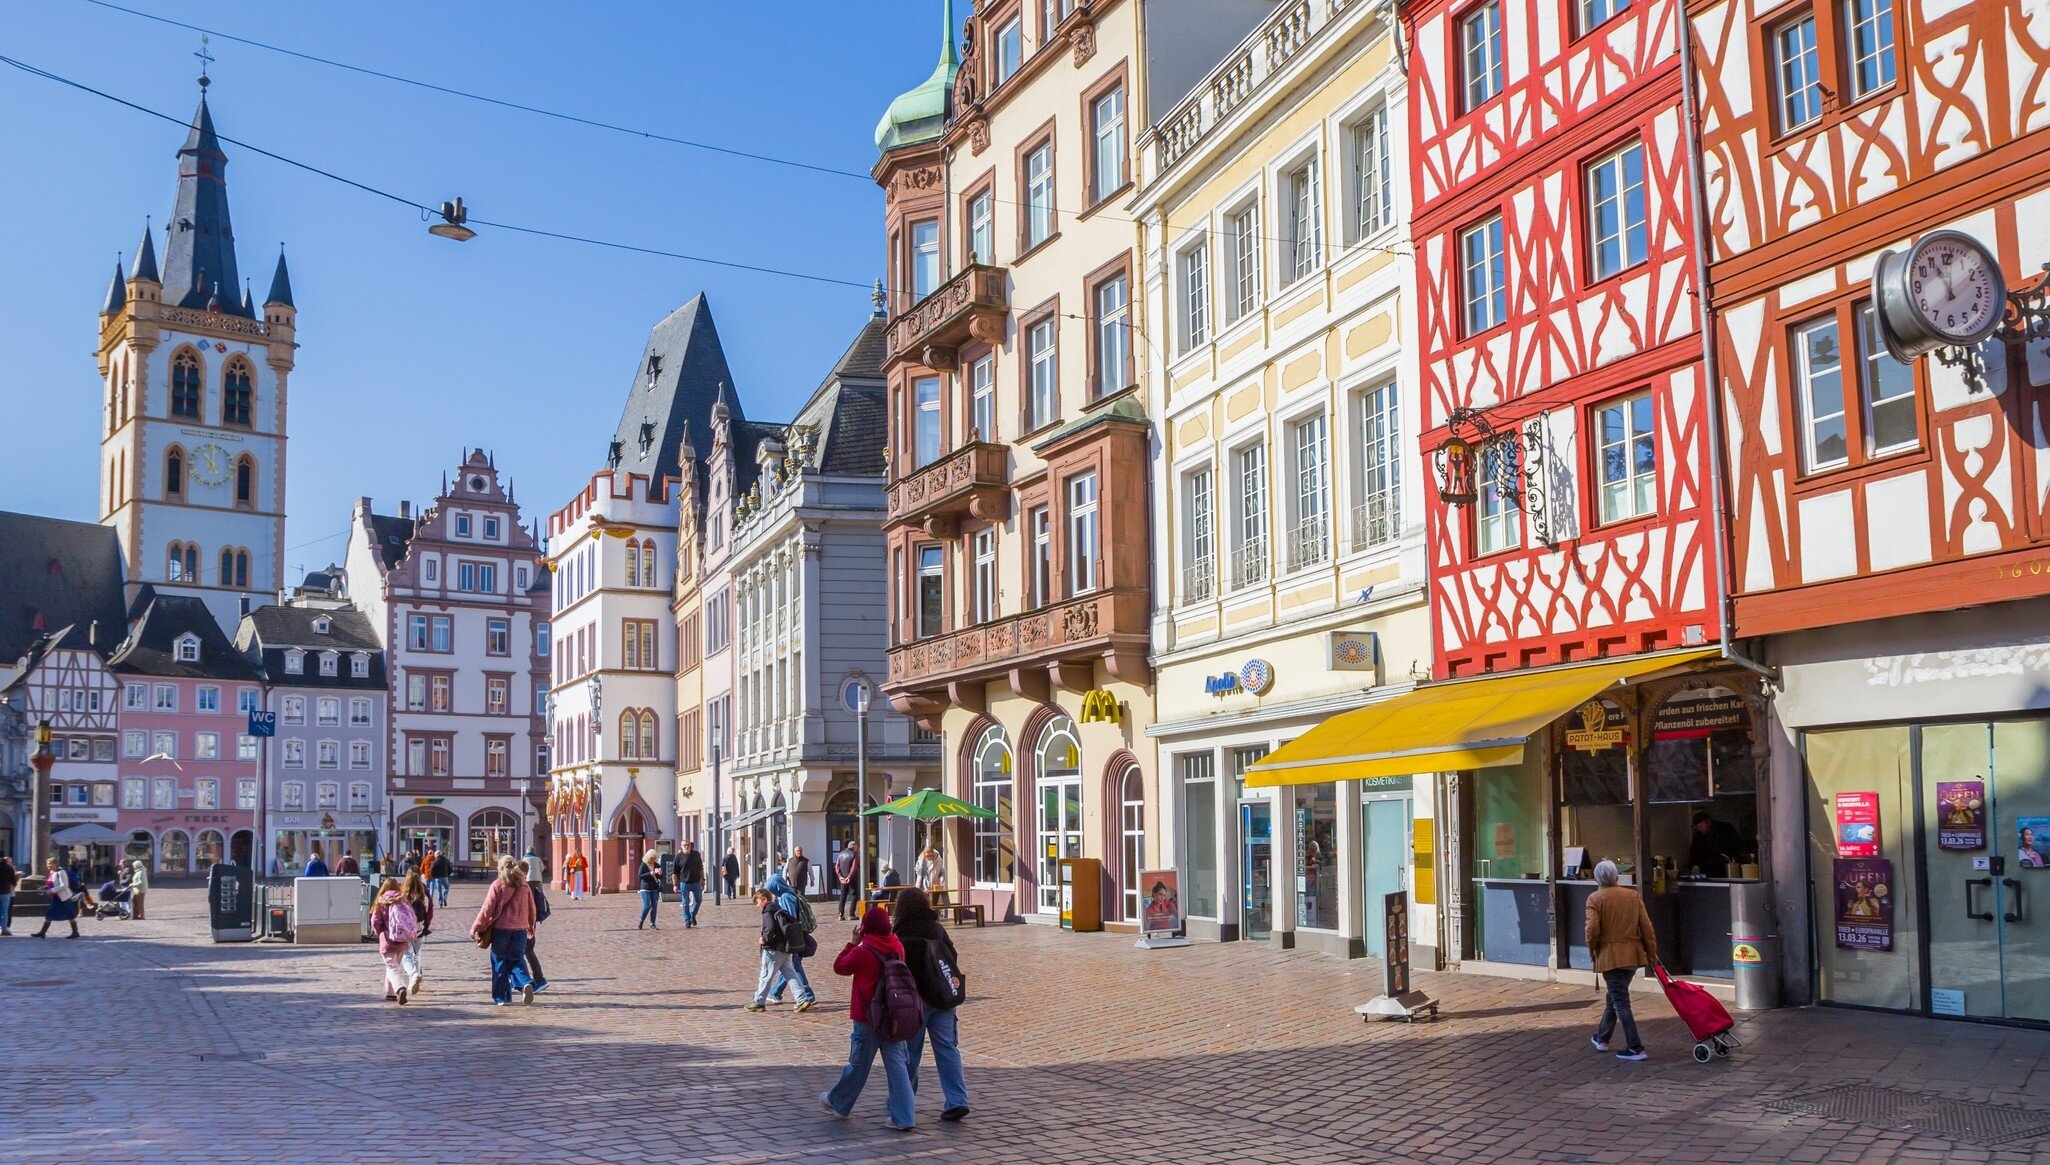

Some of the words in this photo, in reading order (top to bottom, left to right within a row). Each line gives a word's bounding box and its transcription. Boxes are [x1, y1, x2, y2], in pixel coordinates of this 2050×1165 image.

[1927, 257, 1935, 269] 11
[1941, 253, 1953, 266] 12
[1919, 265, 1928, 278] 10
[1968, 268, 1976, 281] 2
[1914, 280, 1922, 294] 9
[1975, 286, 1983, 299] 3
[1920, 298, 1928, 312] 8
[1971, 302, 1979, 314] 4
[1933, 310, 1939, 321] 7
[1947, 314, 1955, 327] 6
[1962, 312, 1968, 324] 5
[1681, 705, 1695, 715] aus
[1696, 701, 1729, 713] frischen
[252, 711, 274, 723] WC
[1695, 713, 1740, 728] zubereitet!
[1570, 731, 1620, 743] PATAT-HAUS
[1939, 789, 1979, 804] QUEEN
[284, 816, 300, 824] BAR
[1838, 870, 1887, 888] QUEEN
[1838, 932, 1867, 943] 13.03.26
